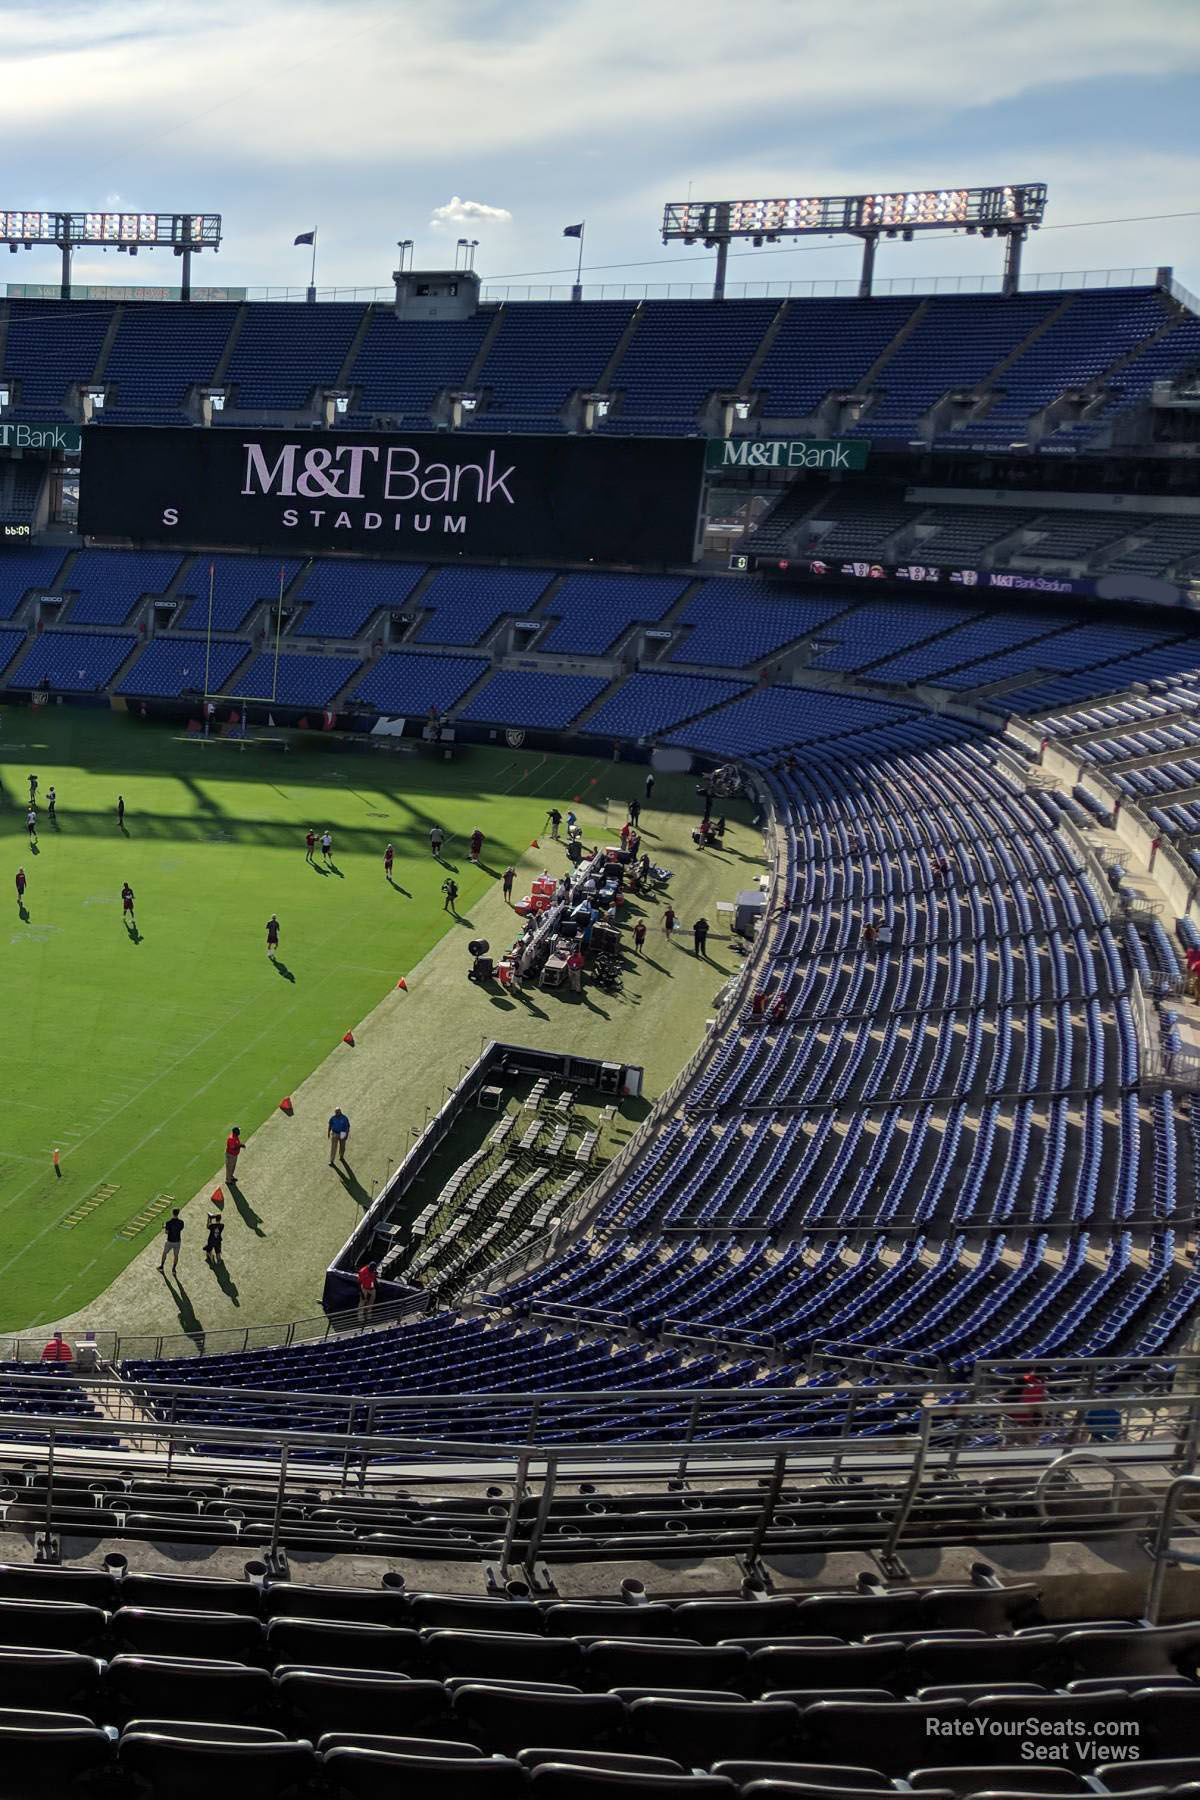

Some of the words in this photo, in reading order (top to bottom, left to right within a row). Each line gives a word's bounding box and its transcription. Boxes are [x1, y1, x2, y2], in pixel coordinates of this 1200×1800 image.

[15, 425, 66, 449] Bank
[721, 440, 786, 466] M&T
[788, 442, 850, 469] Bank
[240, 442, 380, 499] M&T
[383, 447, 517, 505] Bank
[162, 508, 179, 526] S
[282, 509, 468, 534] STADIUM
[989, 573, 1015, 588] M&T
[1015, 575, 1037, 590] Bank
[1037, 577, 1073, 592] Stadium
